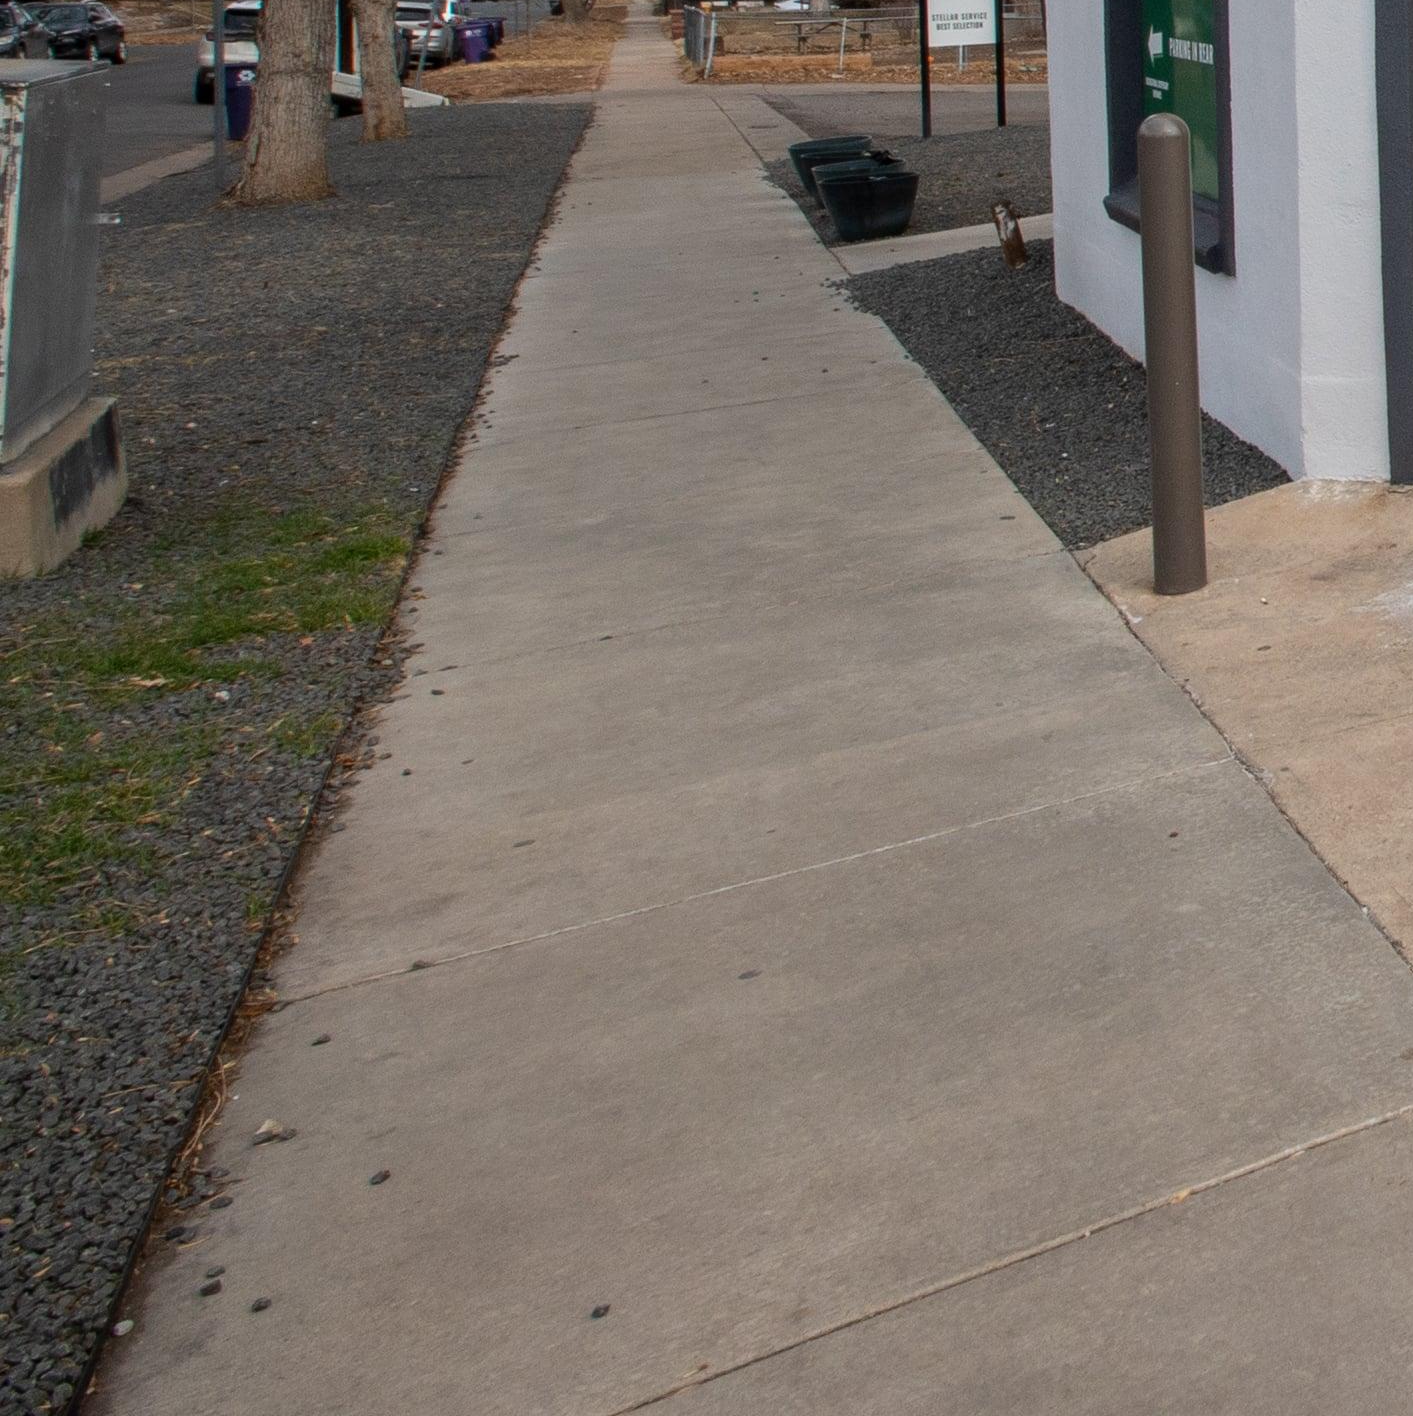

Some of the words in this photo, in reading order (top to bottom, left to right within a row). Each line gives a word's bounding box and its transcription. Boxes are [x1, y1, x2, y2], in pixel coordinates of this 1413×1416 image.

[931, 13, 959, 22] STELLAR
[961, 11, 988, 21] SERVICE
[936, 22, 951, 31] BEST
[952, 21, 984, 30] SELECTION
